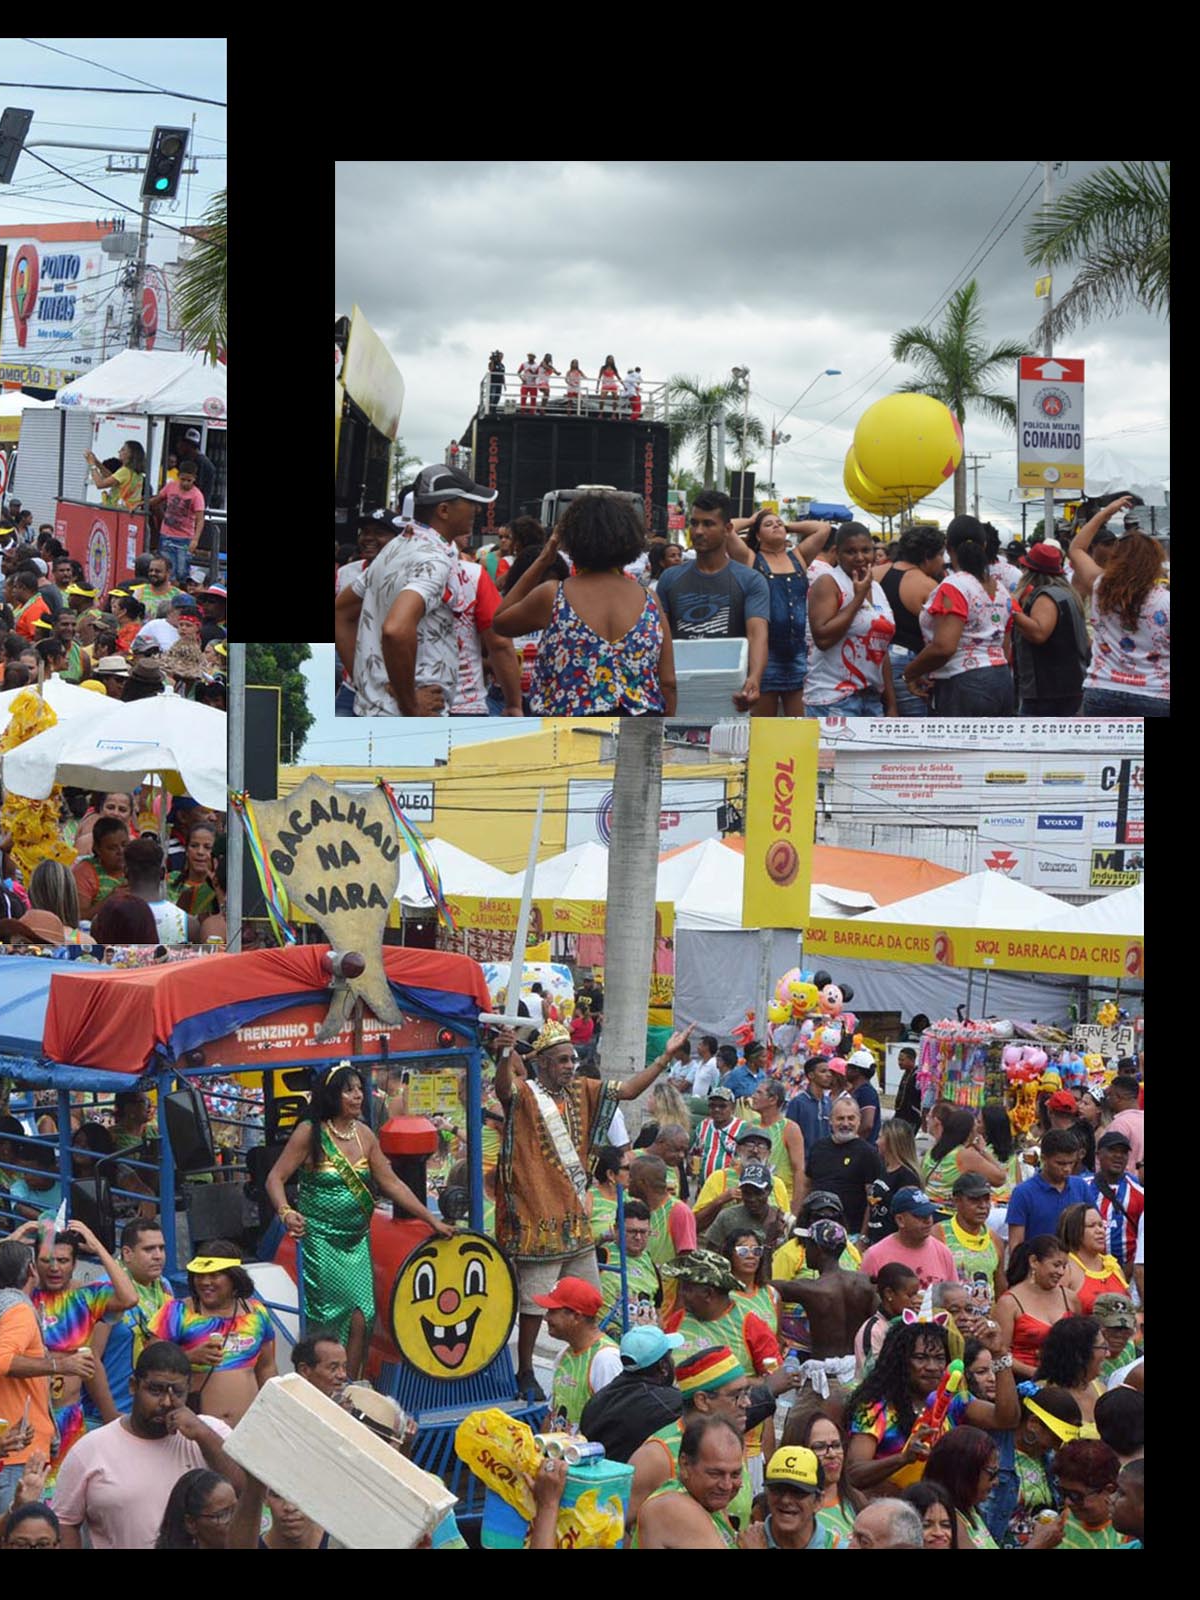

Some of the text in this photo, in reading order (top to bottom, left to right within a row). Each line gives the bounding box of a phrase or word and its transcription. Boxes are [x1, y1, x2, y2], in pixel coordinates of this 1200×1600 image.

[41, 254, 81, 280] PONTO
[38, 295, 76, 321] TINTAS
[1023, 421, 1081, 432] POLÍCIA MILITAR
[1023, 431, 1081, 450] COMANDO
[398, 792, 429, 810] ÓLEO
[773, 757, 795, 834] SKOL
[271, 795, 400, 876] BACALHAU
[316, 840, 361, 871] NA
[1092, 871, 1138, 880] Industrial
[305, 883, 388, 915] VARA
[806, 928, 930, 951] SKOL BARRACA DA CRIS
[975, 939, 1120, 963] SKOL BARRACA DA CRIS
[235, 1023, 308, 1042] TRENZINHO
[477, 1449, 518, 1488] SKOL
